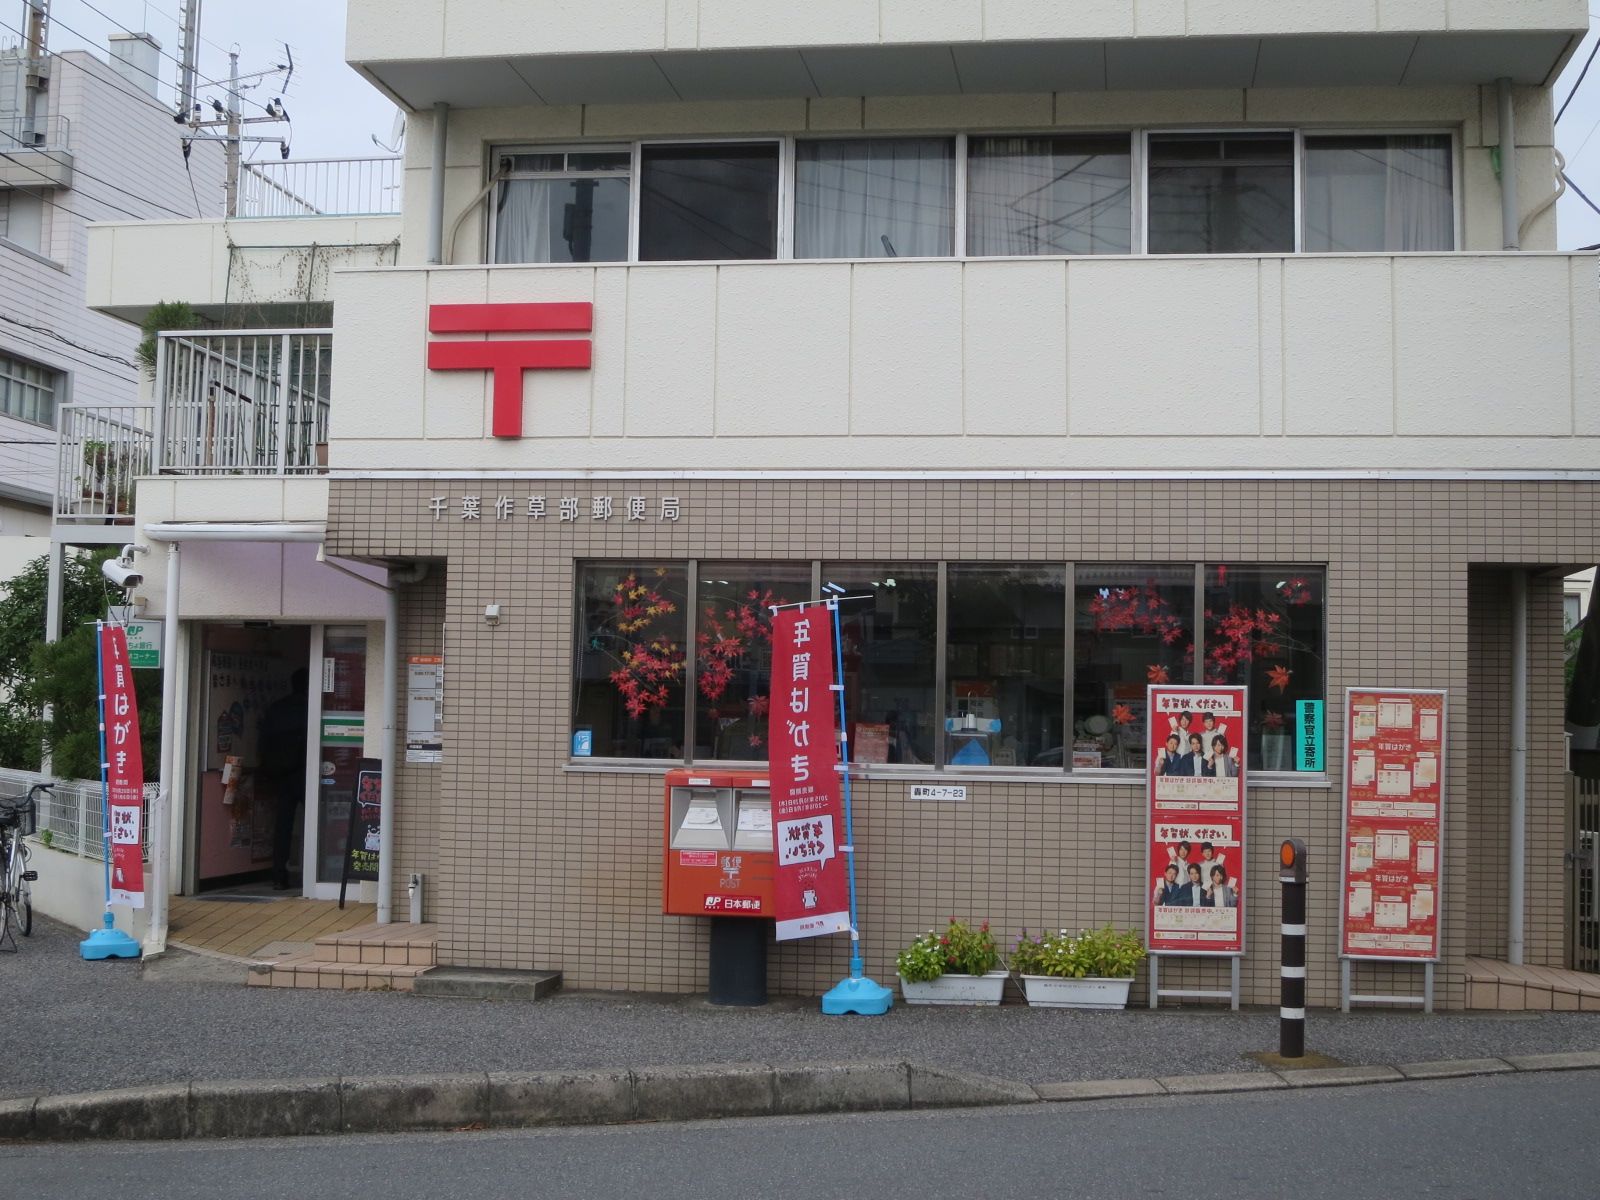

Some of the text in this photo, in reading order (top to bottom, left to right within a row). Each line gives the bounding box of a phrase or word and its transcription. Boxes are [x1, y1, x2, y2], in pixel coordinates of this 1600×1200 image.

[428, 496, 681, 521] 千葉作草部郵便局
[112, 637, 132, 774] 賀はがき
[1161, 697, 1229, 710] 年賀状、ください。
[1304, 702, 1316, 769] 警察官立寄所
[1378, 743, 1412, 751] 年賀はがき
[1160, 827, 1228, 840] 年賀状、ください。
[721, 856, 742, 868] 郵便
[720, 879, 742, 889] POST
[1375, 874, 1409, 883] 年賀はがき
[724, 899, 761, 910] 日本郵便
